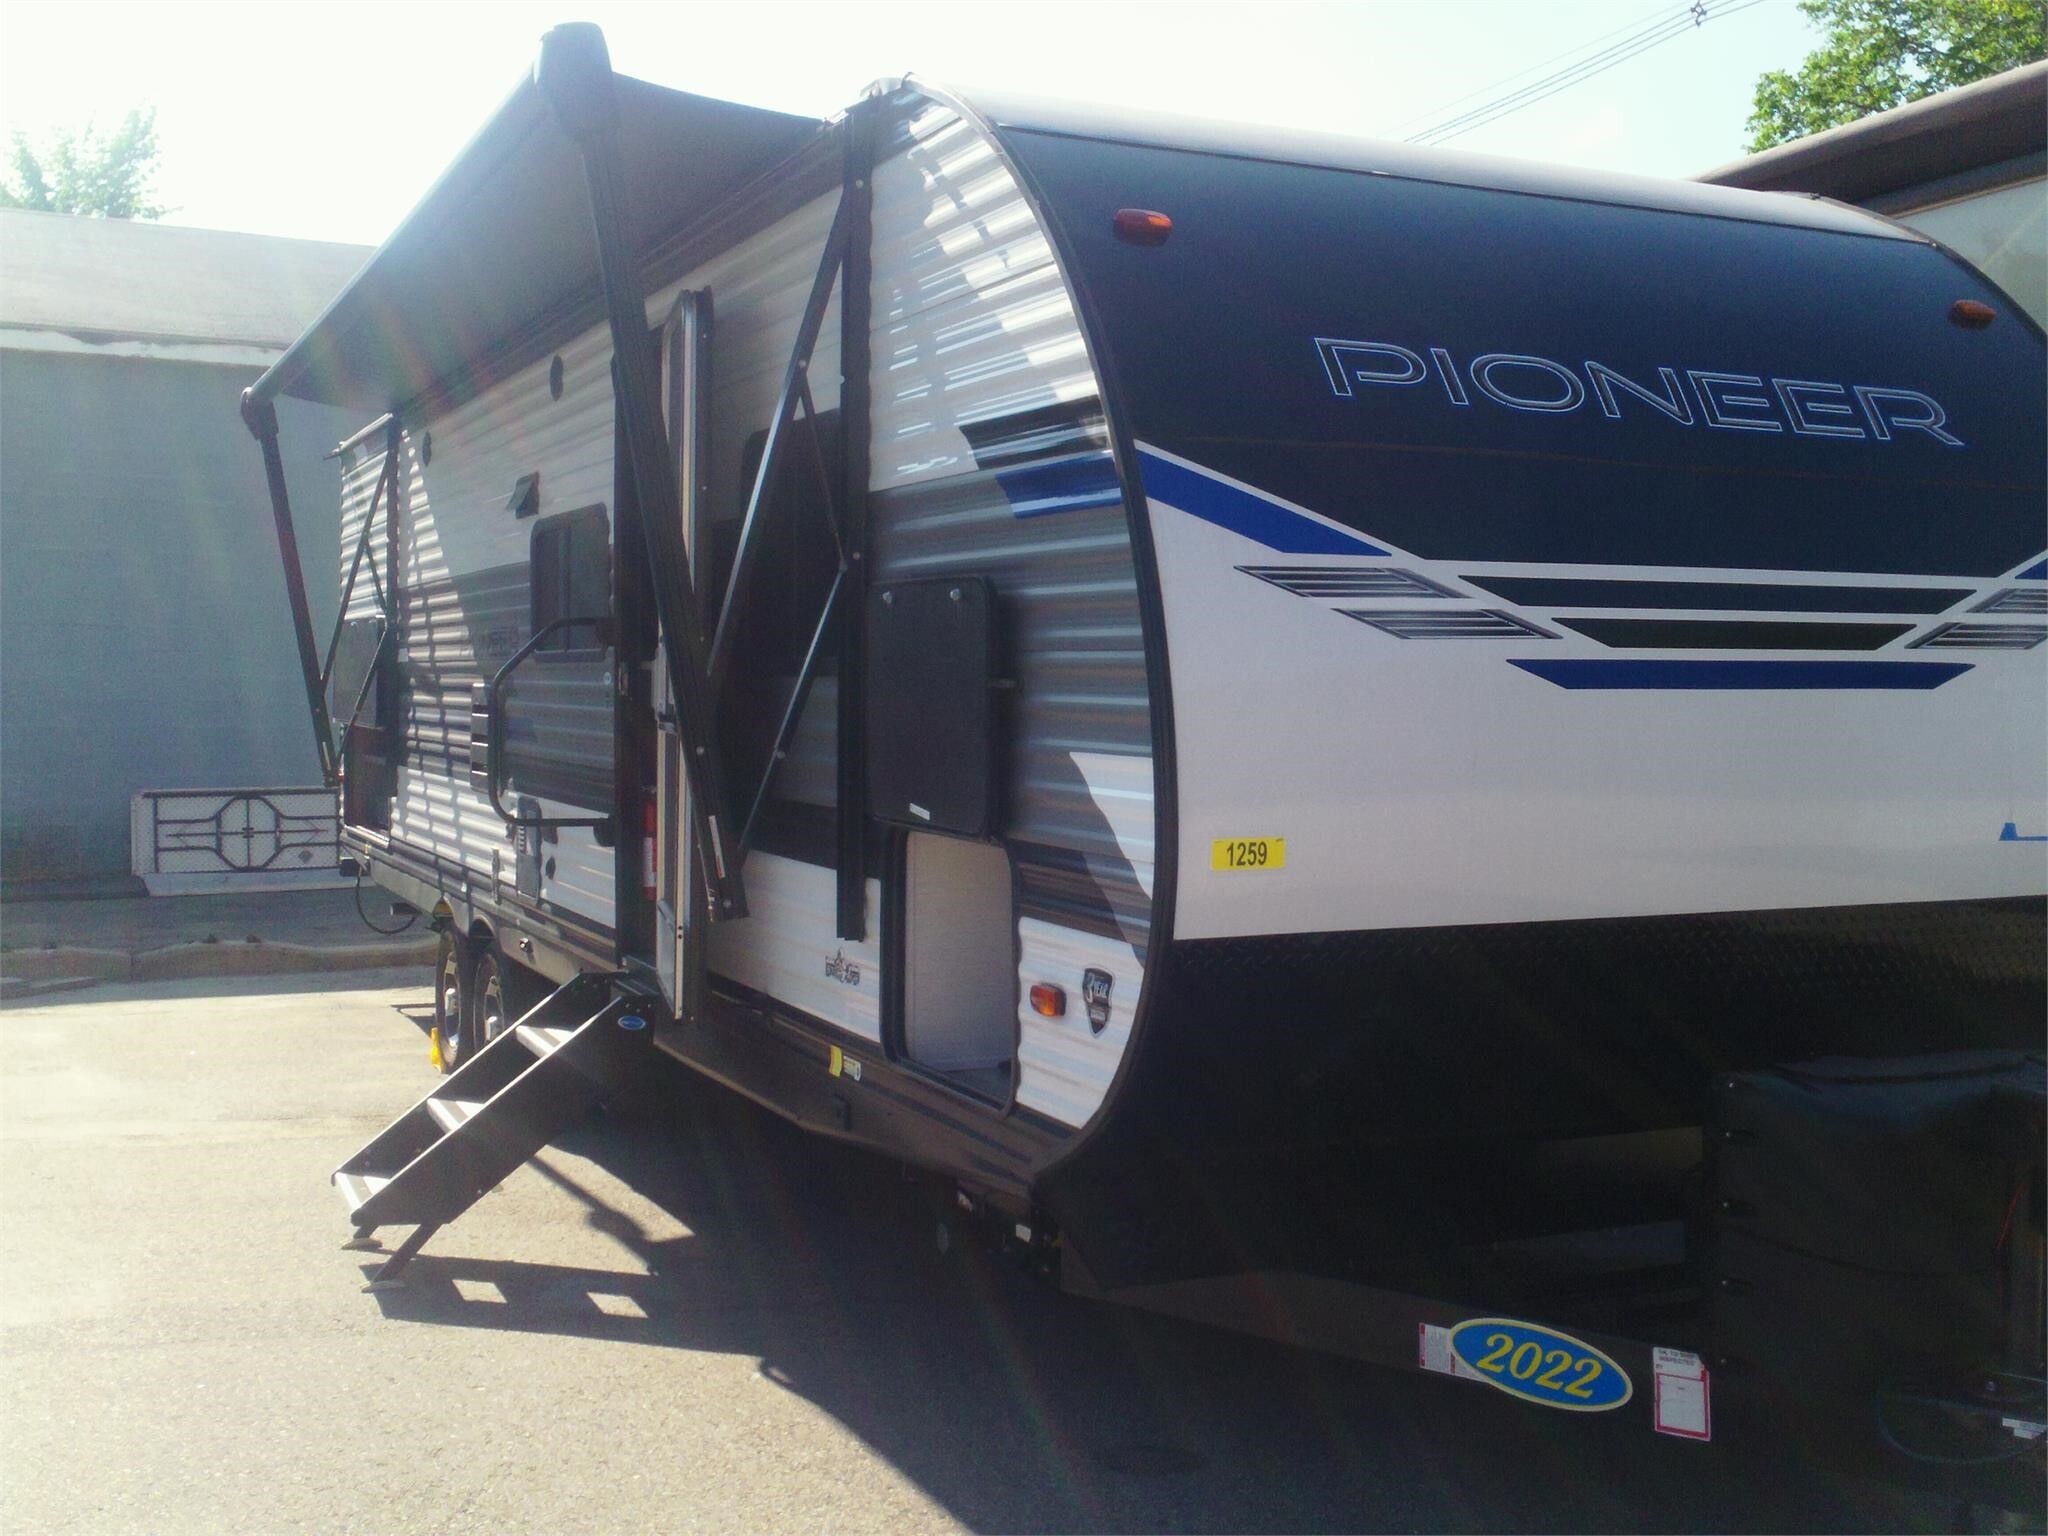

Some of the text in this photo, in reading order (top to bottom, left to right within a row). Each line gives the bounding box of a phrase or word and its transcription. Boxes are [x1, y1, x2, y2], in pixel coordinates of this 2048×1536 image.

[1314, 337, 1965, 446] PIONEER
[1226, 841, 1268, 867] 1259
[1476, 1332, 1603, 1399] 2022
